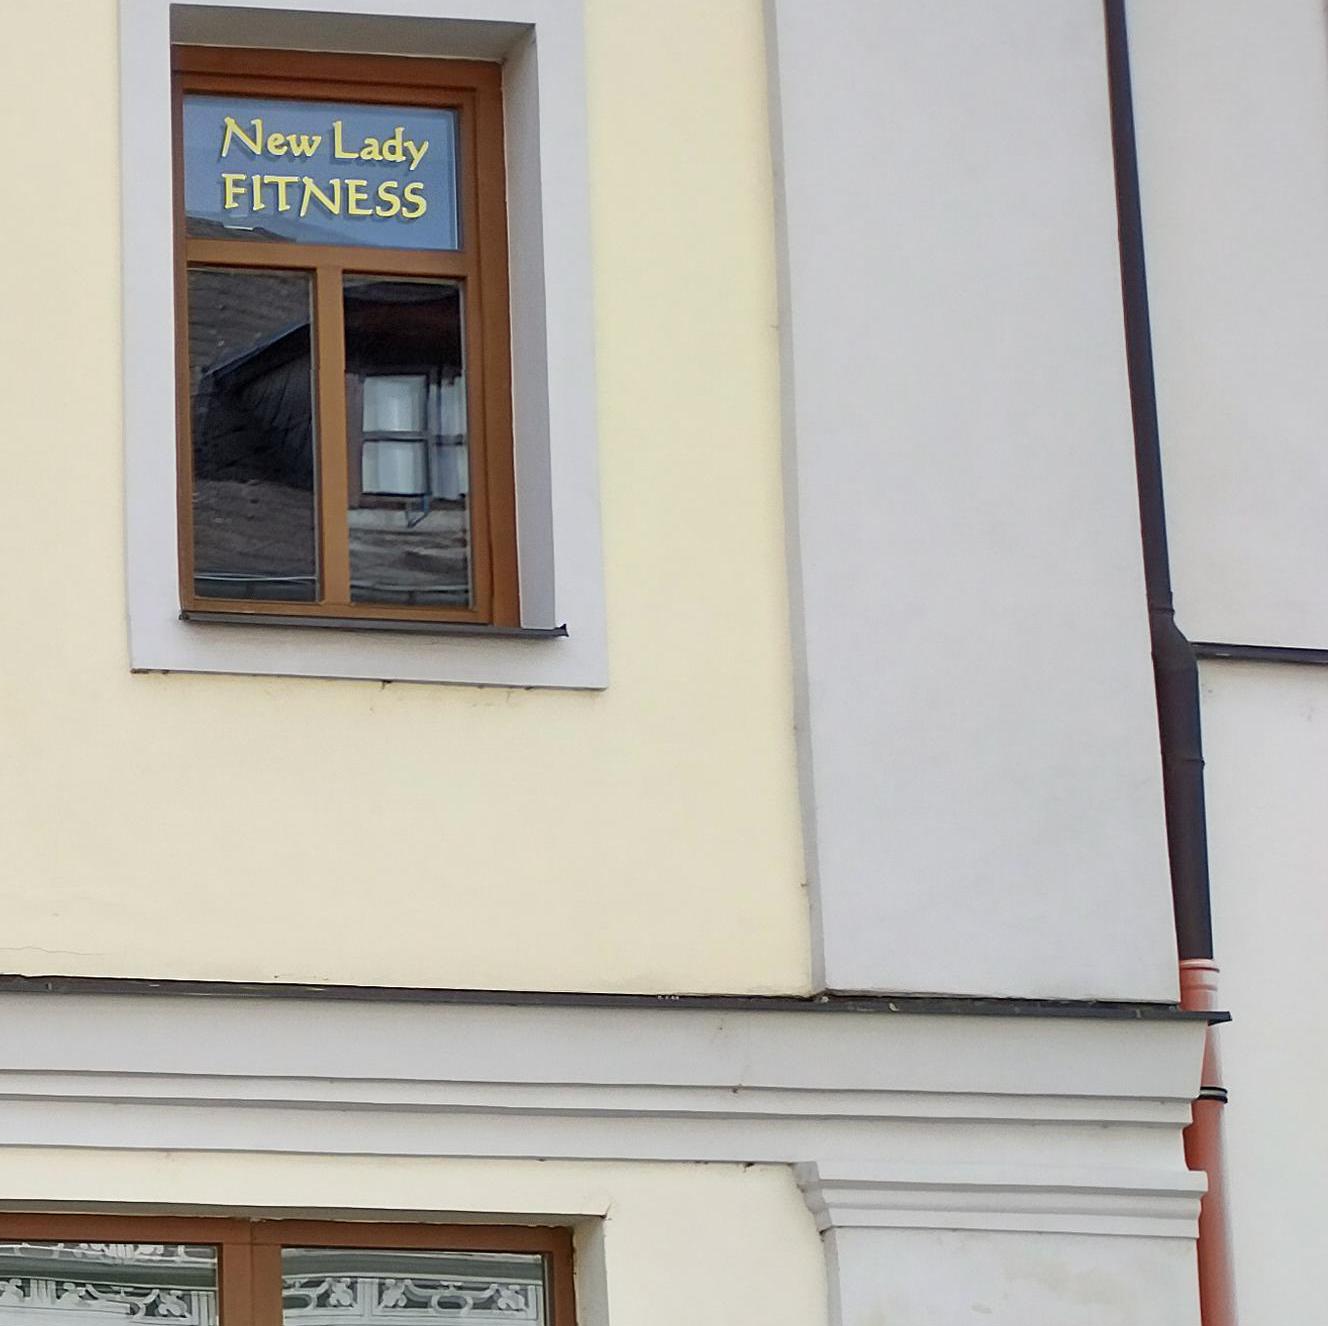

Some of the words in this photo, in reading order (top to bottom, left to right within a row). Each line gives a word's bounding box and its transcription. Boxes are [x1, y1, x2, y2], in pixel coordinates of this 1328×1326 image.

[220, 116, 322, 158] New
[332, 120, 429, 170] Lady
[221, 173, 428, 219] FITNESS
